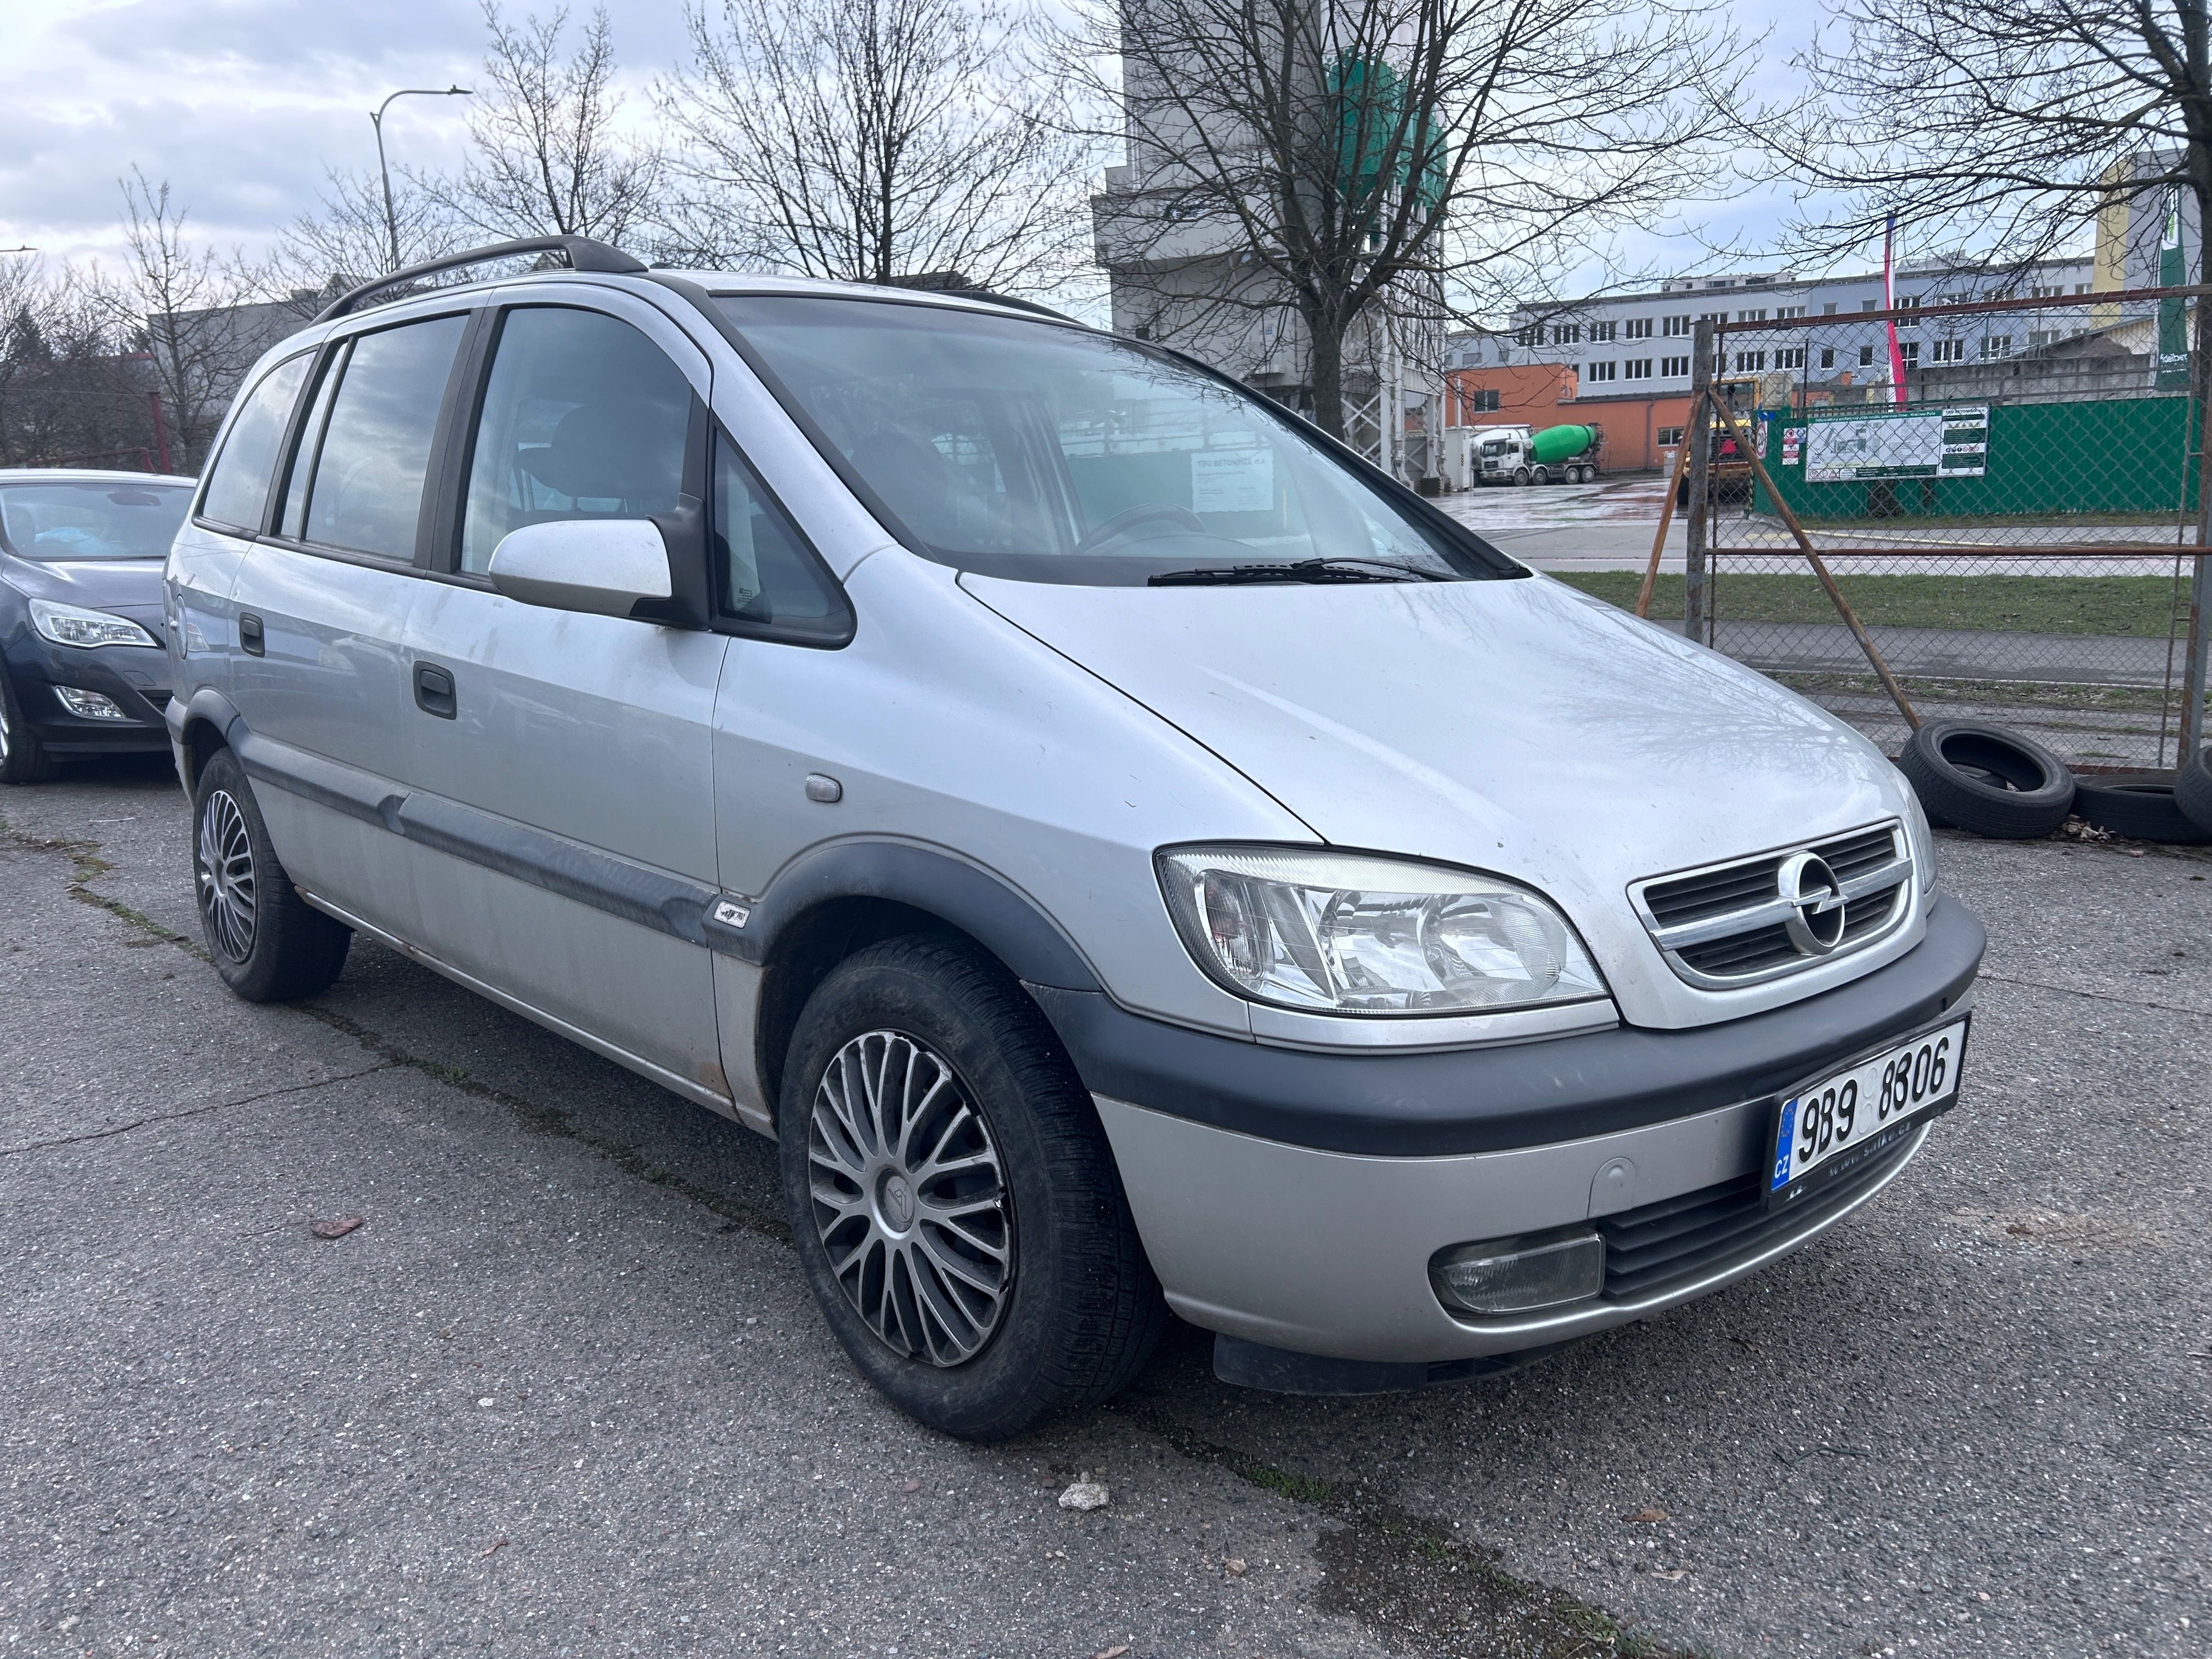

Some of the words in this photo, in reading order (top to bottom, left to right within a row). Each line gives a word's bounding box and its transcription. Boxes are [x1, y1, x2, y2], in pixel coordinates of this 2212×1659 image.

[1799, 1079, 1858, 1163] 9B9
[1878, 1036, 1949, 1120] 8806
[1774, 1154, 1790, 1179] CZ
